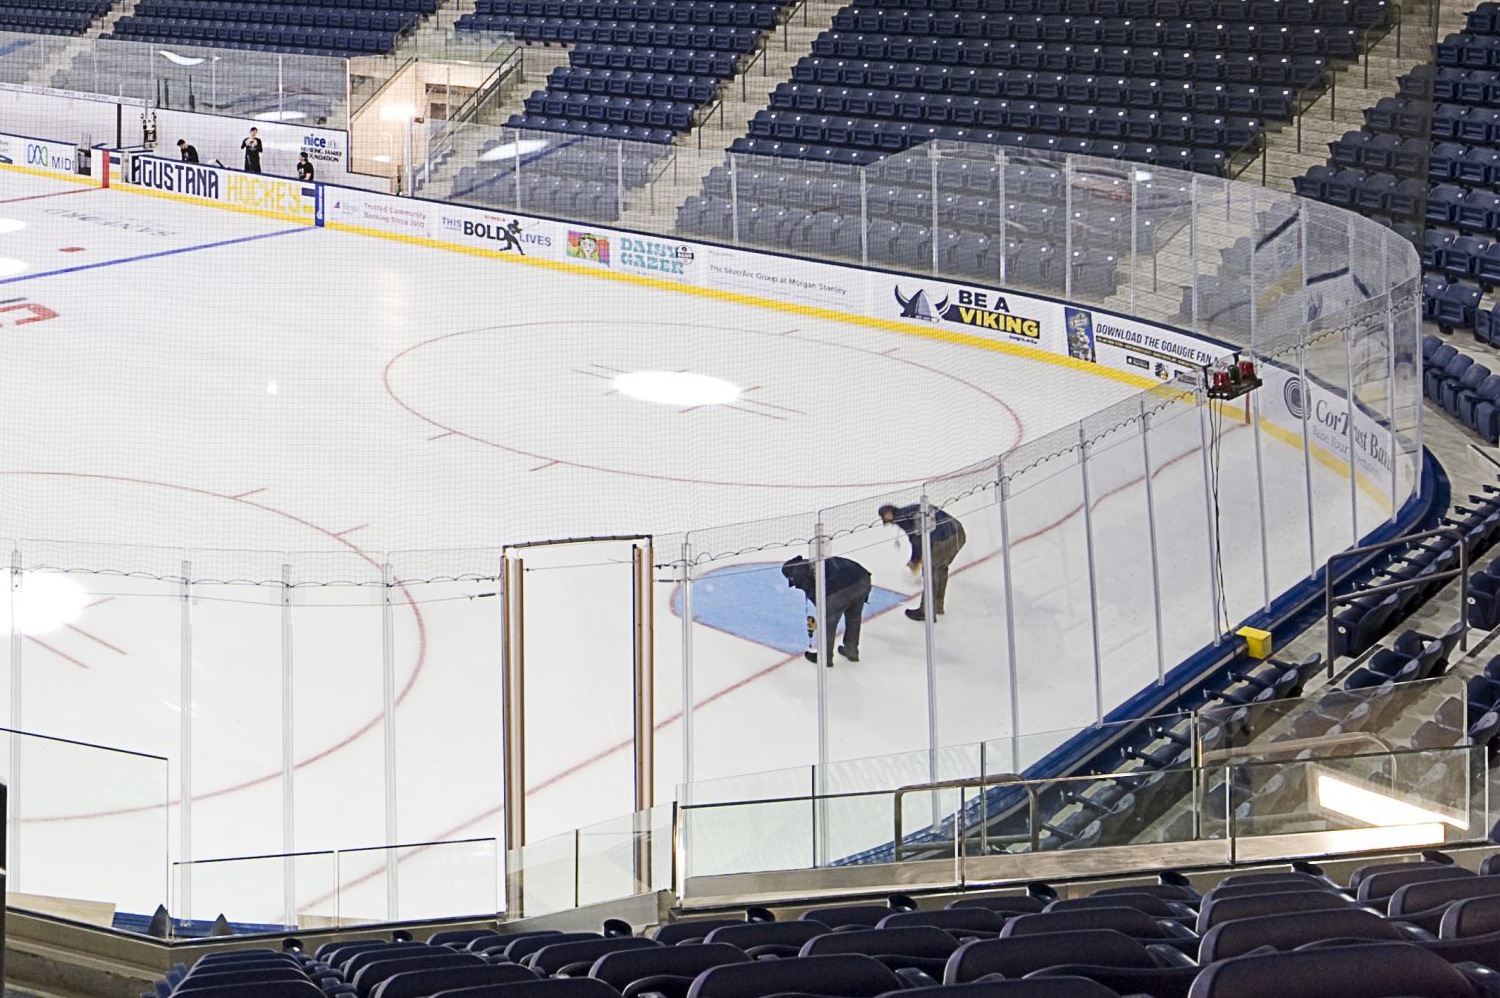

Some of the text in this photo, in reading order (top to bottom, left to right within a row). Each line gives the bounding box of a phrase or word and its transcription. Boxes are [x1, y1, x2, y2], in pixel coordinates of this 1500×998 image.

[304, 133, 326, 148] nice
[308, 153, 339, 162] OUNDATION
[227, 174, 301, 215] HOCKEY
[364, 202, 388, 213] Trusted
[389, 207, 426, 220] Community
[364, 212, 390, 223] Banking
[391, 216, 408, 226] Since
[442, 217, 552, 247] THIS BOLD LIVES
[620, 251, 685, 275] GAZER
[709, 264, 722, 273] The
[755, 272, 779, 284] Group
[788, 278, 817, 290] Morgan
[819, 283, 847, 295] Stanley
[958, 289, 1011, 313] BE A
[958, 307, 1039, 337] VIKING
[1096, 323, 1143, 344] DOWNLOAD
[1144, 335, 1160, 349] THE
[1161, 340, 1195, 360] GOAUGIE
[1196, 351, 1212, 363] FAN
